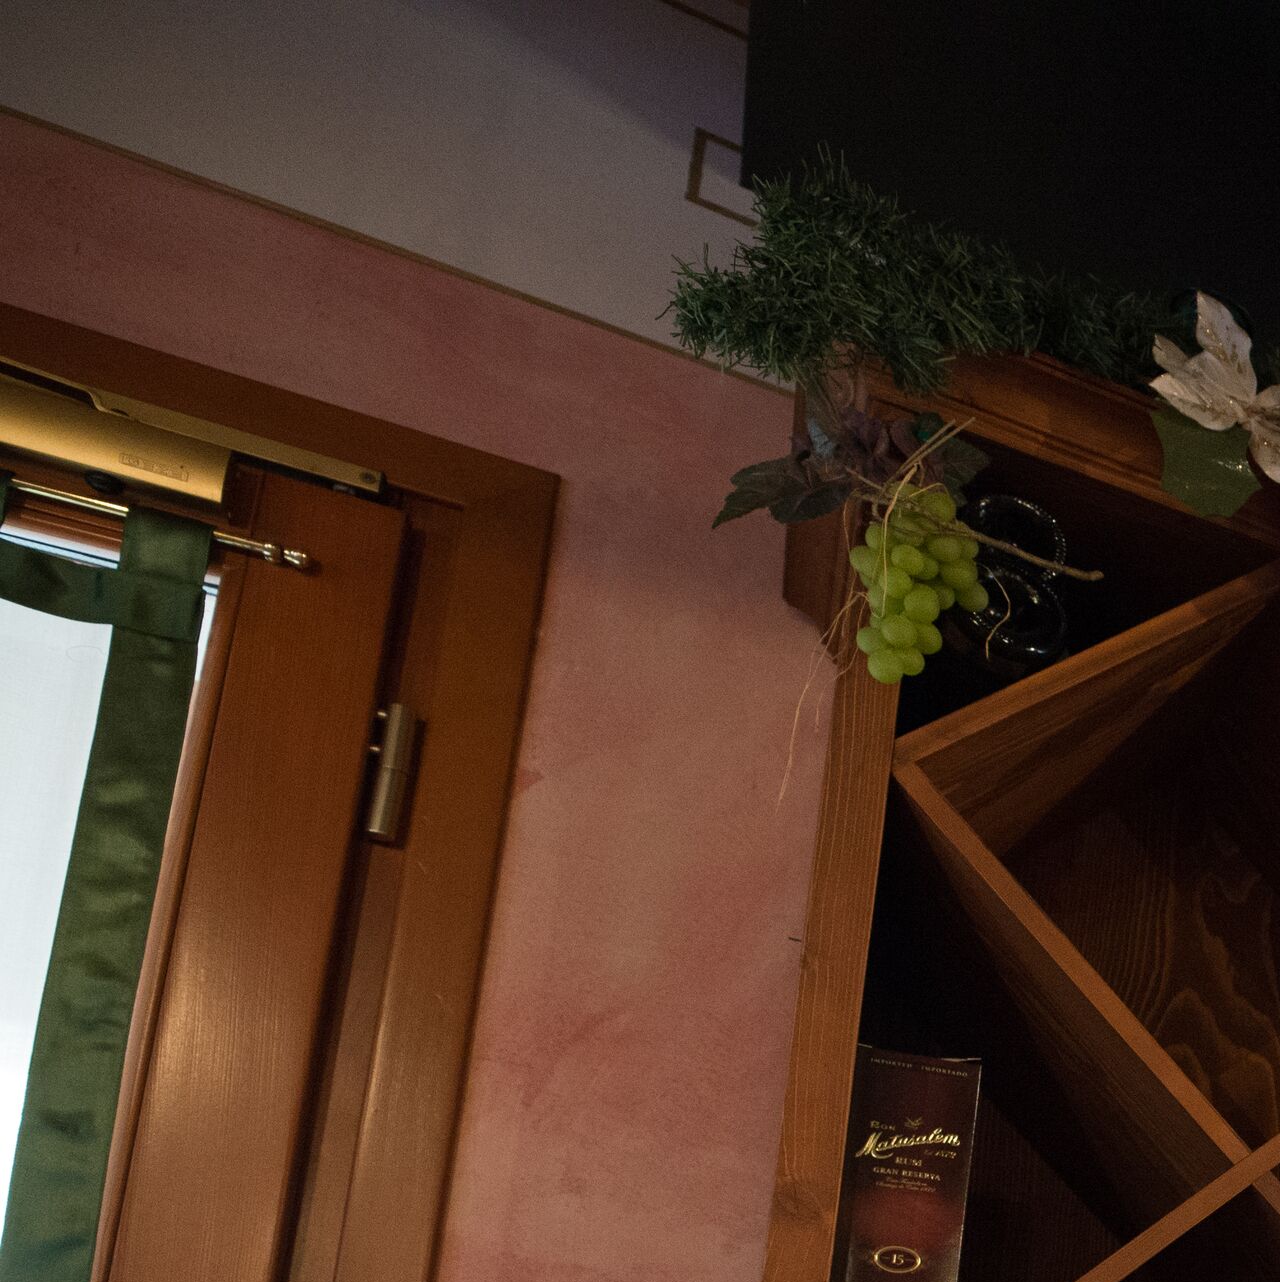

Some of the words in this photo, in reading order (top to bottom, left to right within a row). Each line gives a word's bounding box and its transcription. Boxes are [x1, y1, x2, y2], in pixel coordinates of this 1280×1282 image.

[855, 1128, 960, 1159] Matusalem
[872, 1166, 900, 1176] GRAN
[892, 1254, 905, 1266] 15
